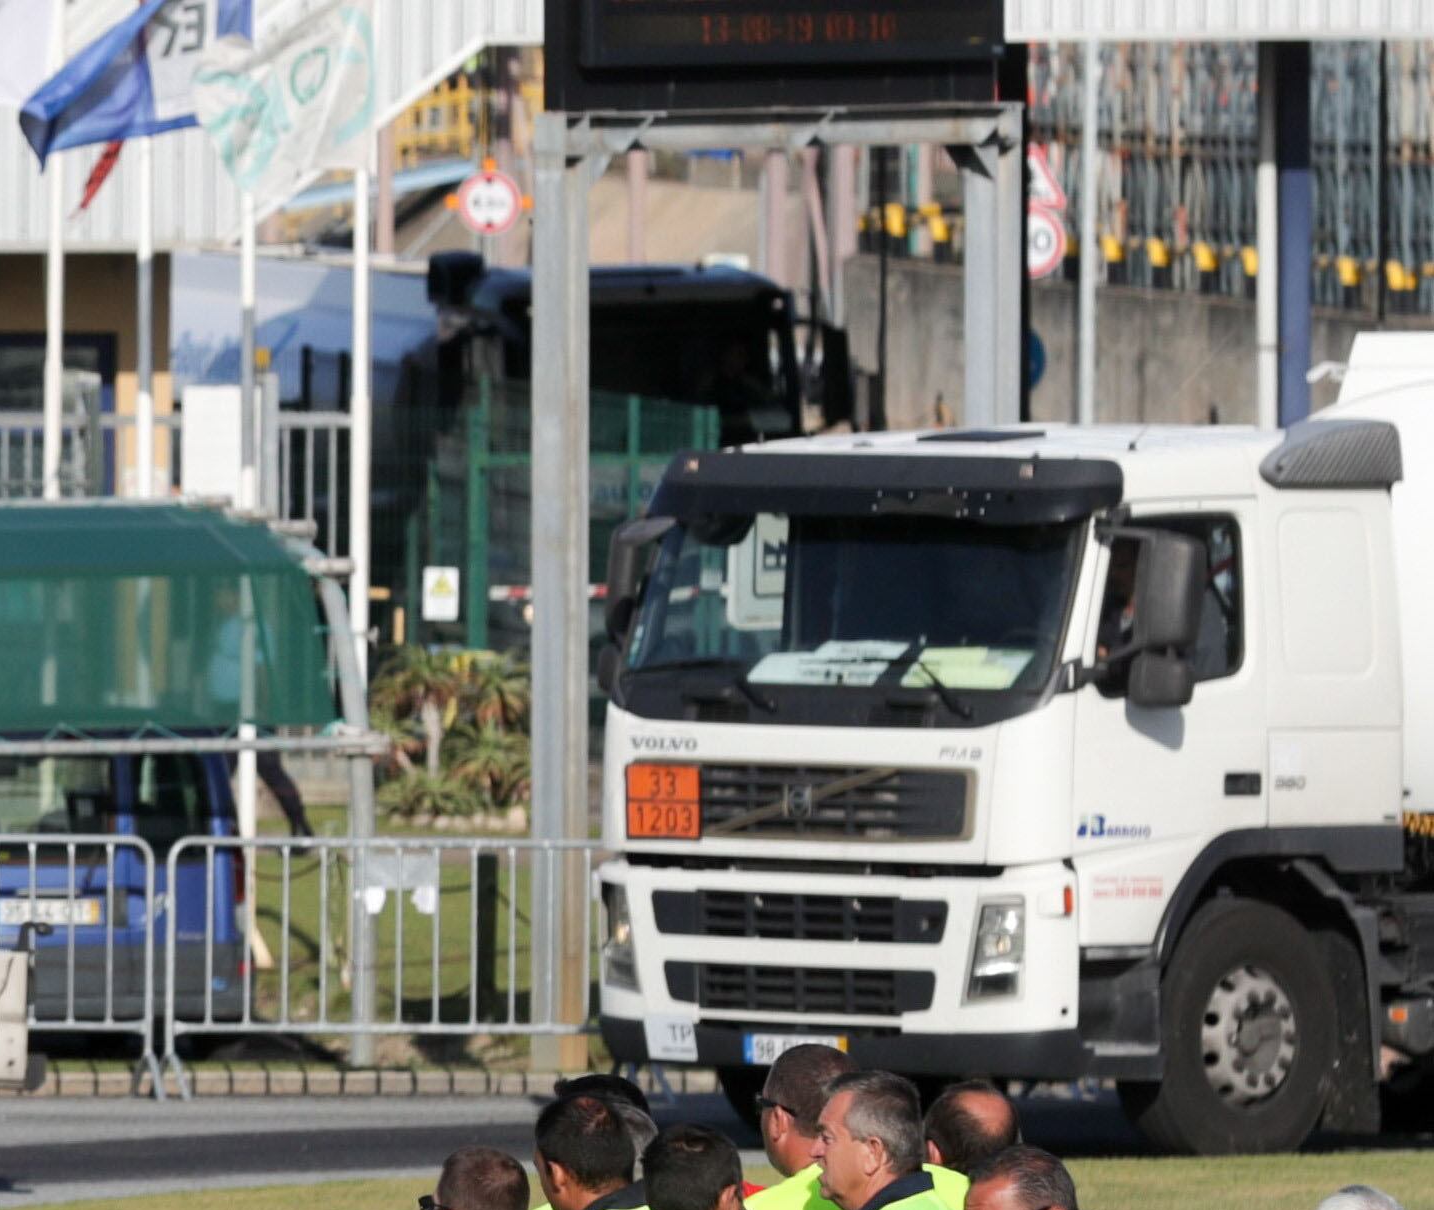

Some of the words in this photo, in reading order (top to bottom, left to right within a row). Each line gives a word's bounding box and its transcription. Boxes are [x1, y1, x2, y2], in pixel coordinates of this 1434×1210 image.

[629, 736, 698, 752] VOLVO
[649, 770, 678, 799] 33
[635, 806, 694, 834] 1203
